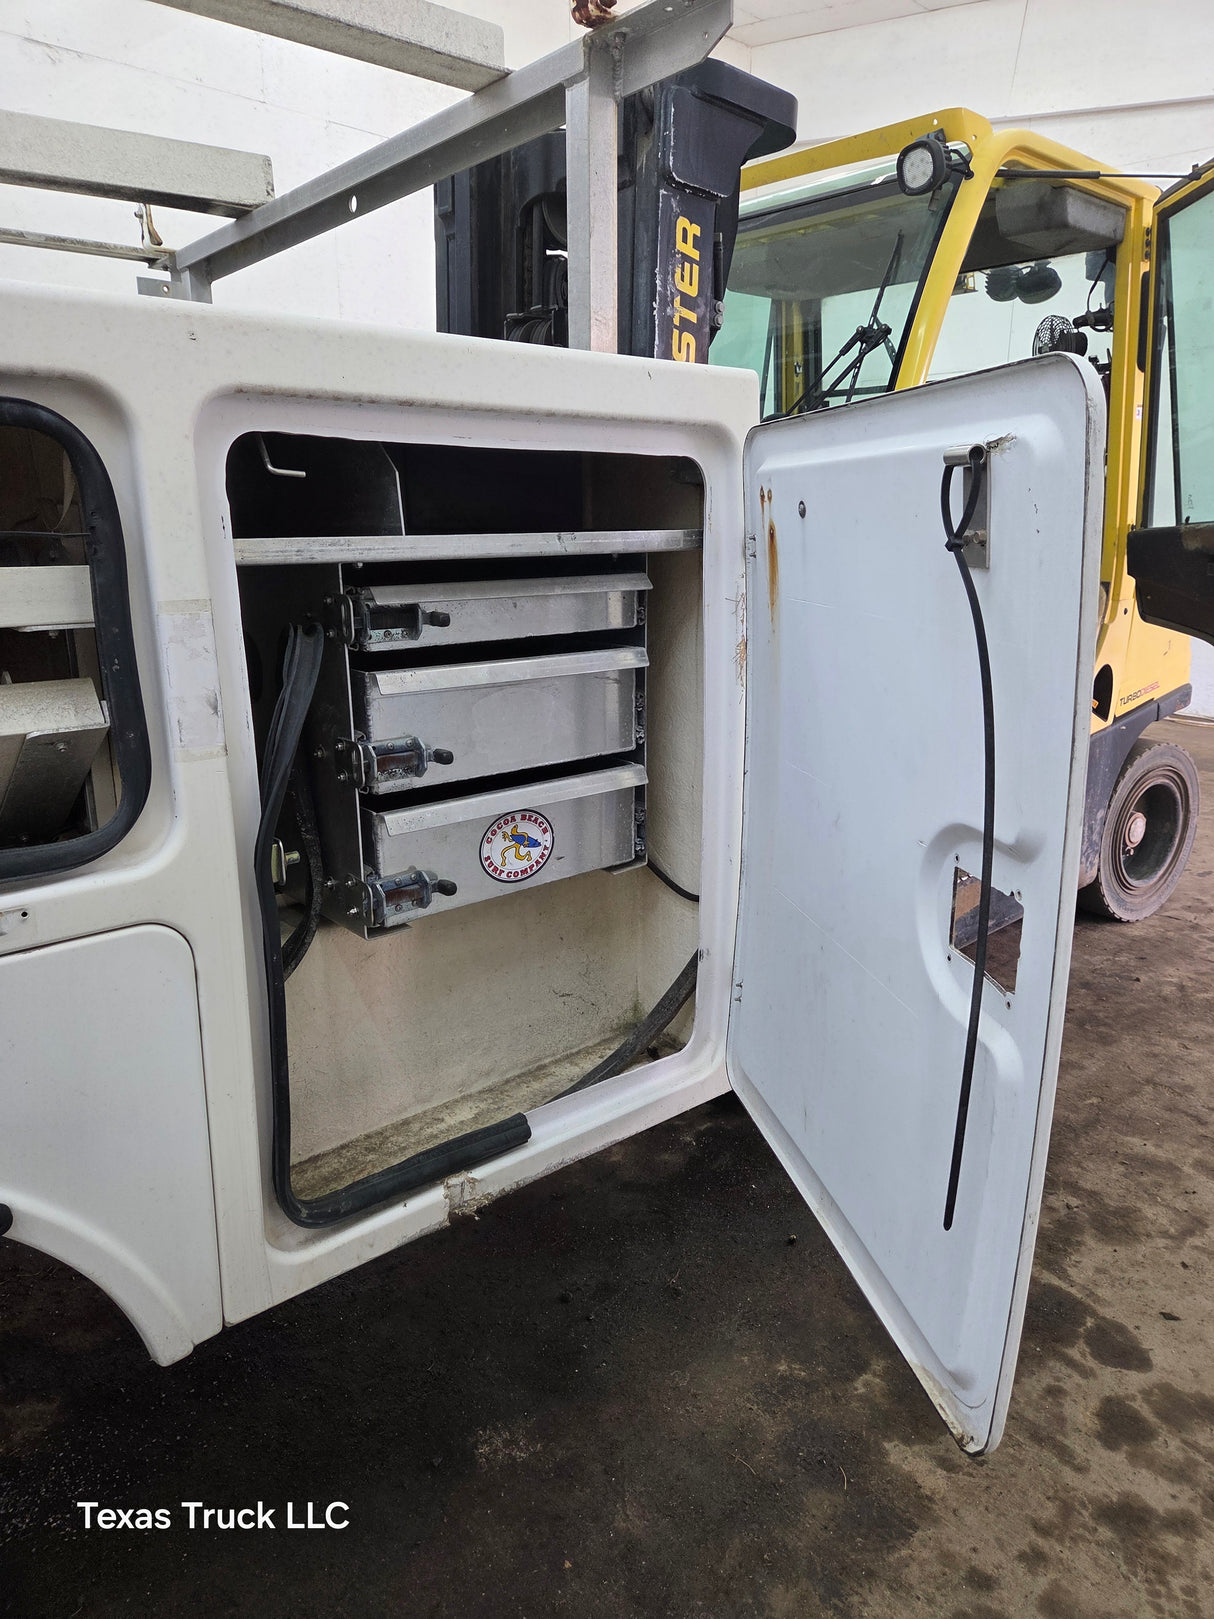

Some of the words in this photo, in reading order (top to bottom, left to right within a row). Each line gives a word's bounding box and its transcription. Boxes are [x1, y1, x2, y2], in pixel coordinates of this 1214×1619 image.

[672, 216, 700, 363] STER
[486, 815, 516, 844] COCOA
[520, 814, 548, 835] BEACH
[484, 855, 505, 876] SURF
[506, 844, 549, 878] COMPANY
